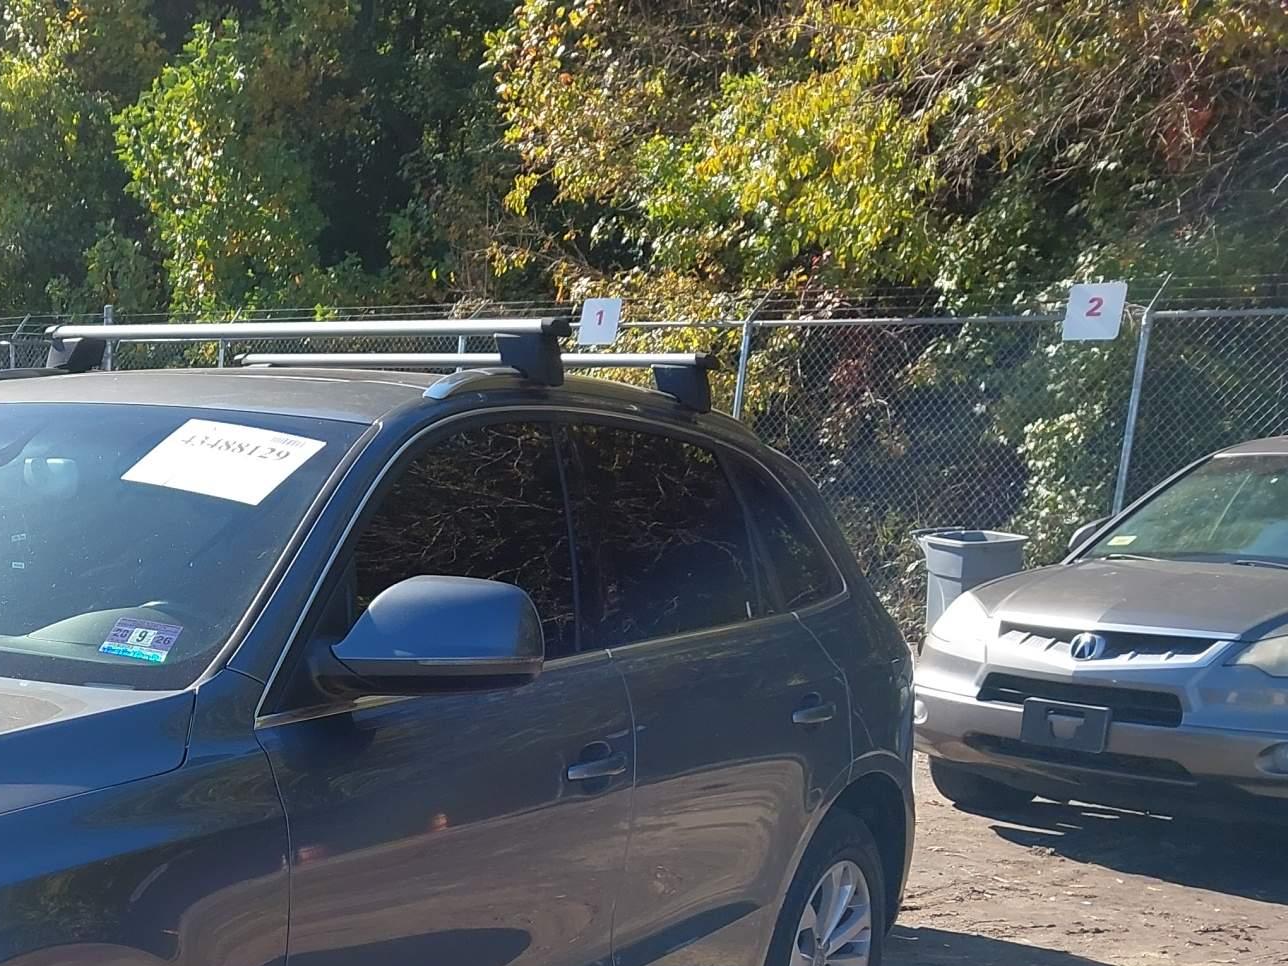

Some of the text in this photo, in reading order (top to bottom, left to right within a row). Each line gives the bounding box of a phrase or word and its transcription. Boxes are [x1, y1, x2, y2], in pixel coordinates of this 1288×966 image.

[1085, 296, 1104, 317] 2
[596, 309, 604, 325] 1
[181, 435, 291, 460] 43488129
[113, 628, 172, 645] 20 9 26
